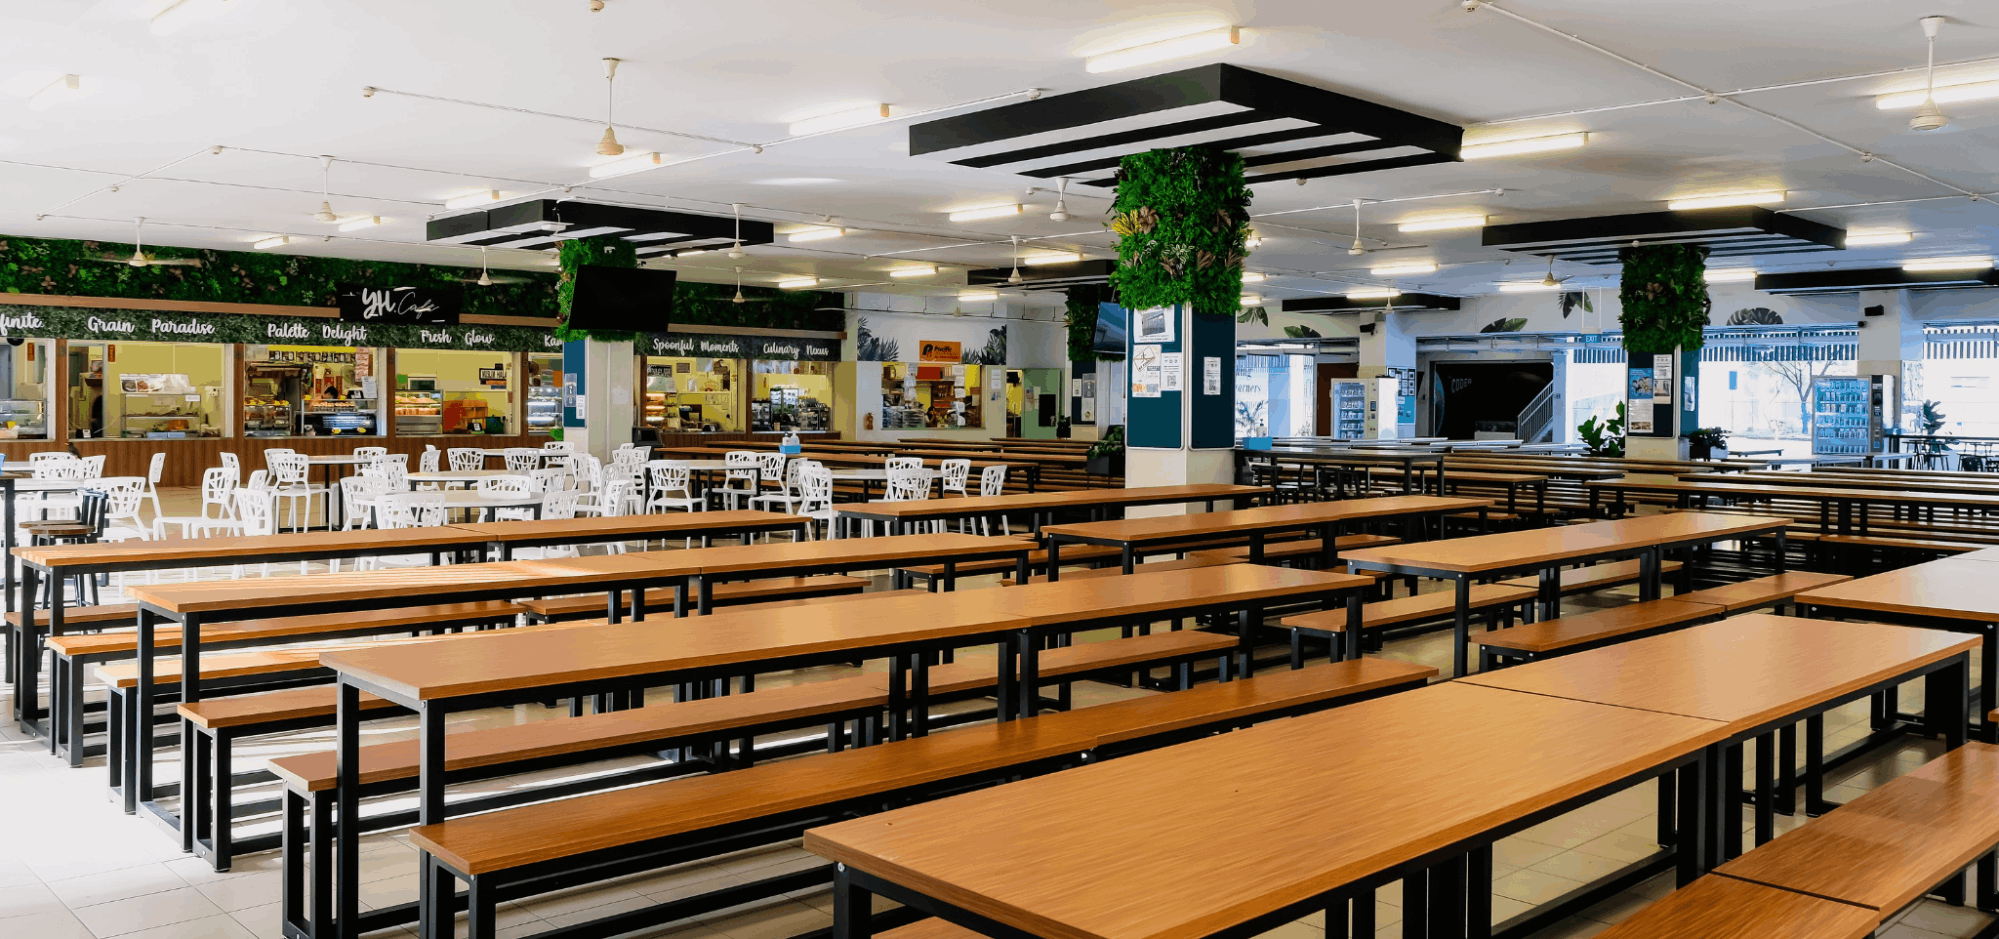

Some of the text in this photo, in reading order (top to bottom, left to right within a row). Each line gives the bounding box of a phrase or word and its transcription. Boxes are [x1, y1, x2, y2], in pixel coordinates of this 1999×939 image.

[87, 315, 216, 335] Grain Paradise
[267, 323, 368, 346] Palette Delight
[420, 328, 495, 346] Fresh Glow
[652, 338, 739, 356] Spoonful Moments
[762, 343, 829, 360] Culinary Nexus
